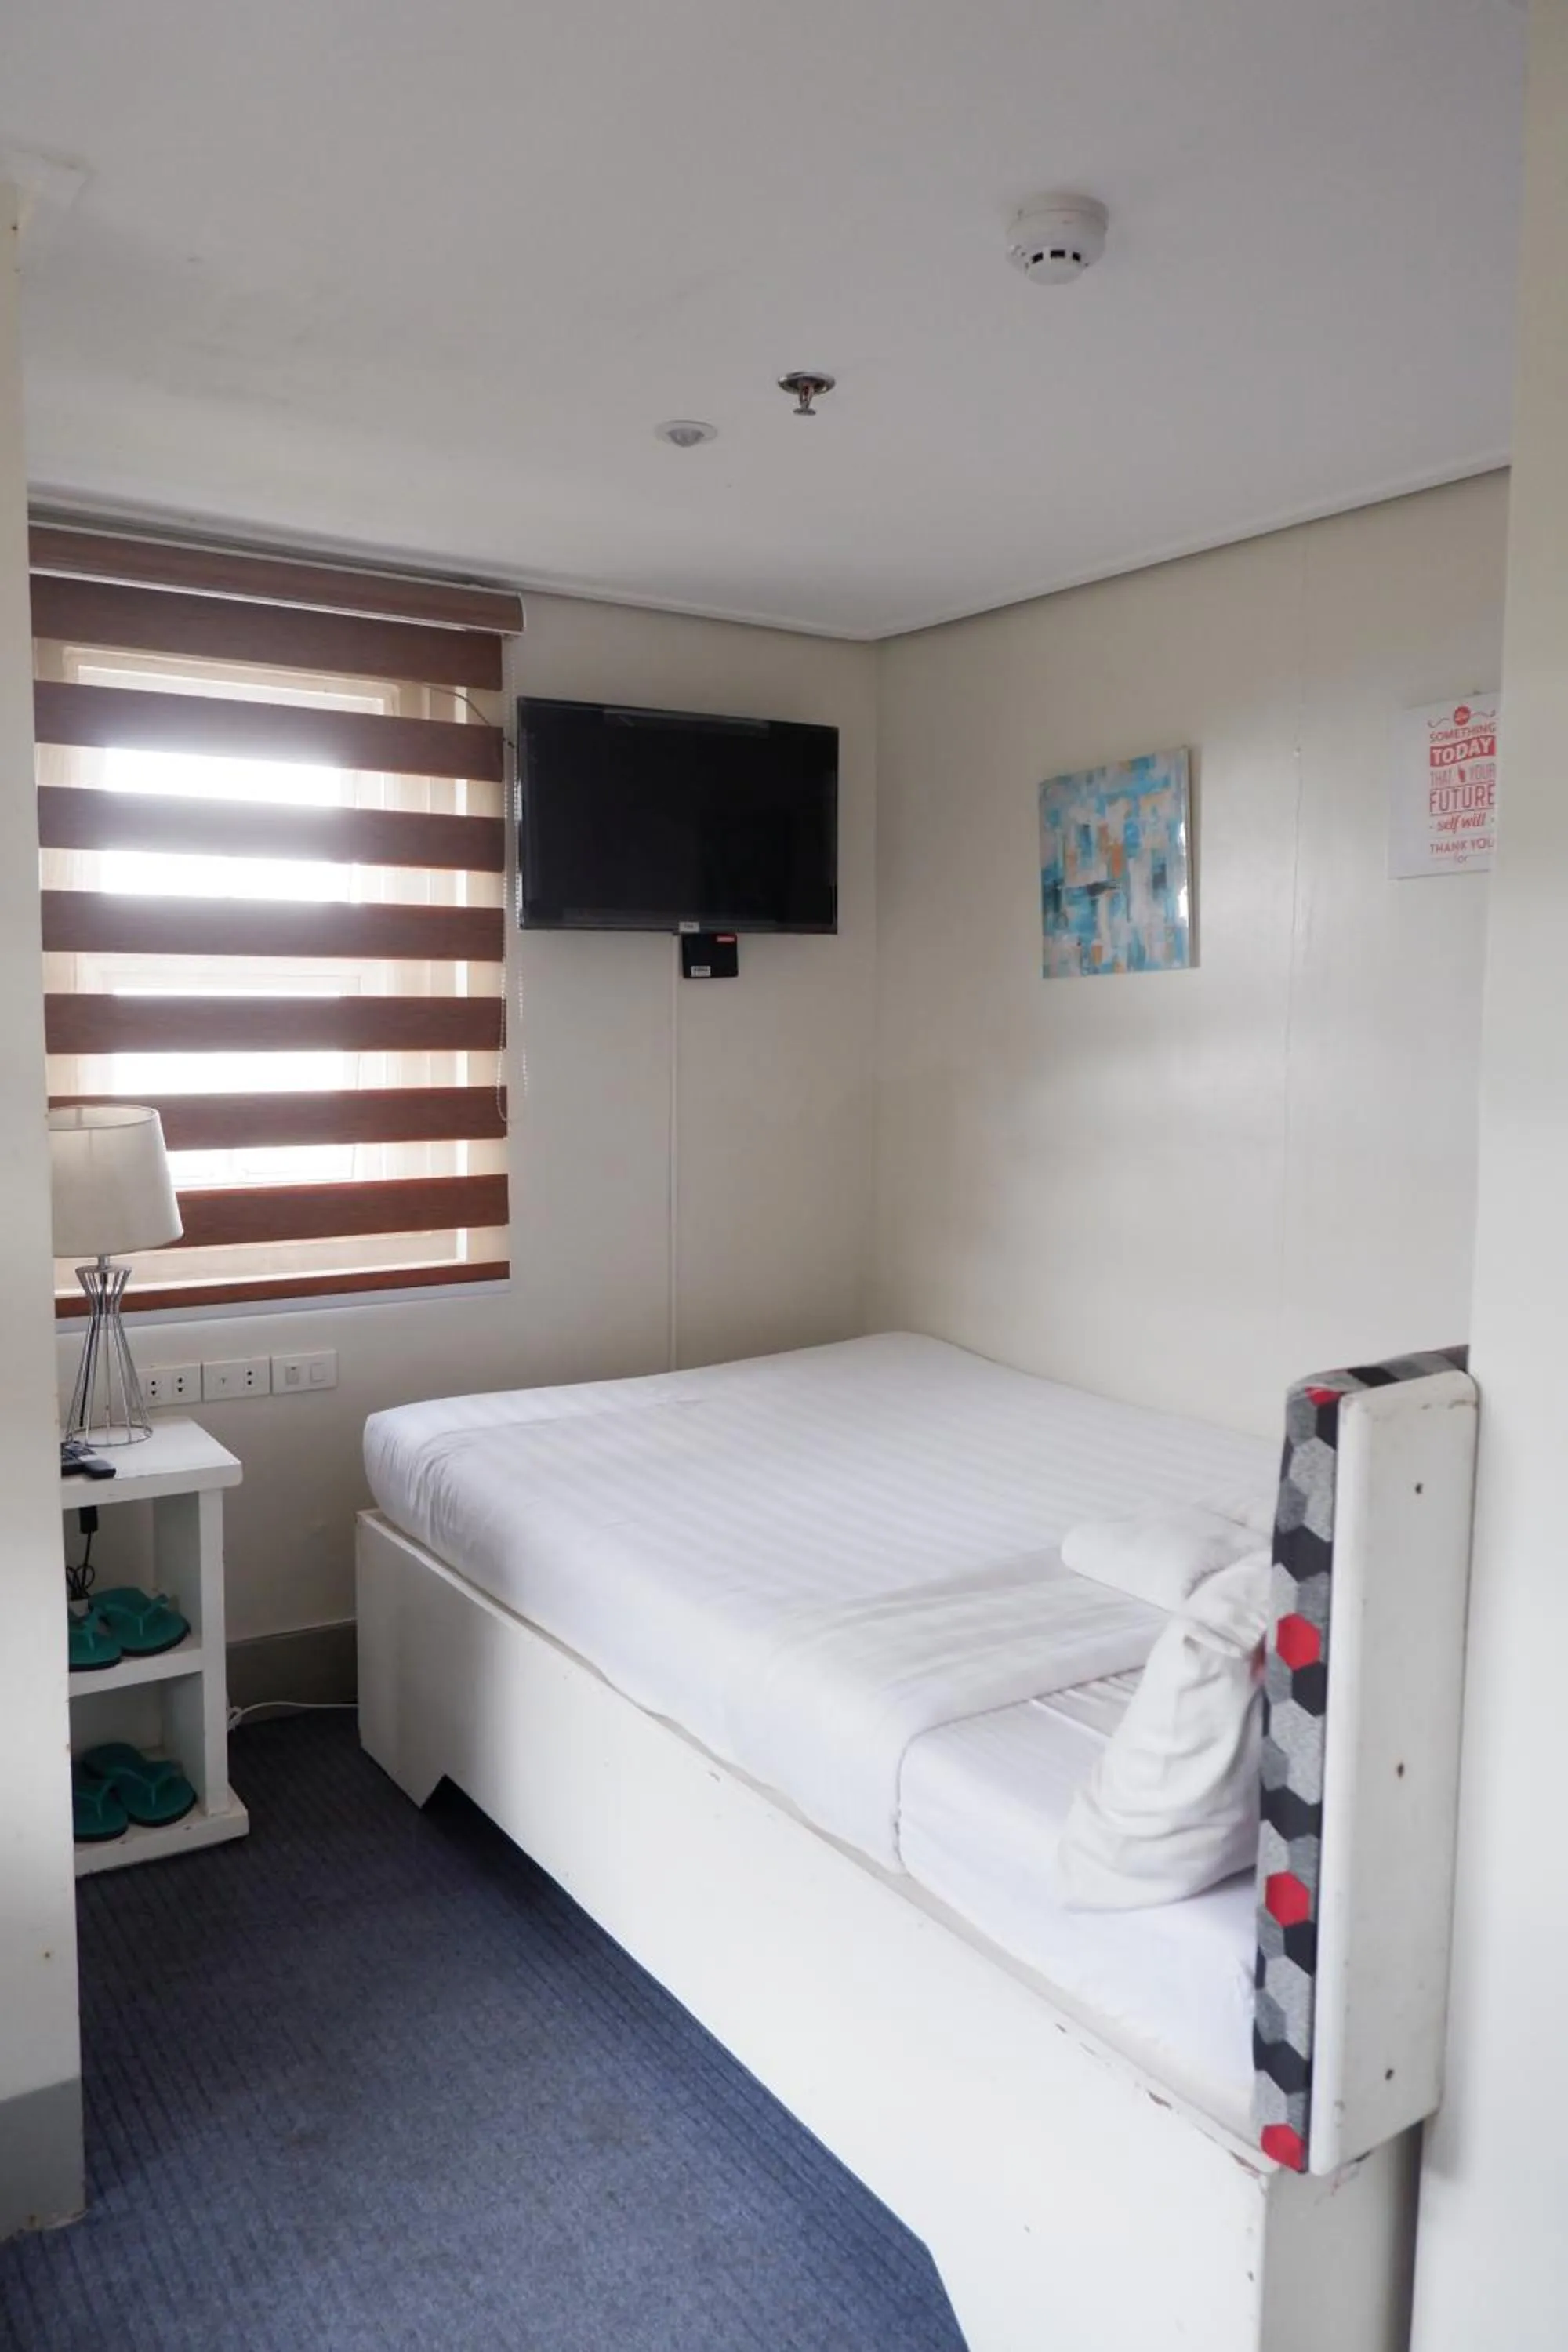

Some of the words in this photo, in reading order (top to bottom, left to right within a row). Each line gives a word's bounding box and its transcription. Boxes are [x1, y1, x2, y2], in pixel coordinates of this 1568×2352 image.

[1430, 722, 1496, 743] SOMETHING
[1432, 737, 1494, 765] TODAY
[1430, 783, 1495, 813] FUTURE
[1437, 815, 1461, 834] self
[1461, 812, 1486, 829] will
[1430, 840, 1467, 854] THANK
[1471, 837, 1494, 850] YOU
